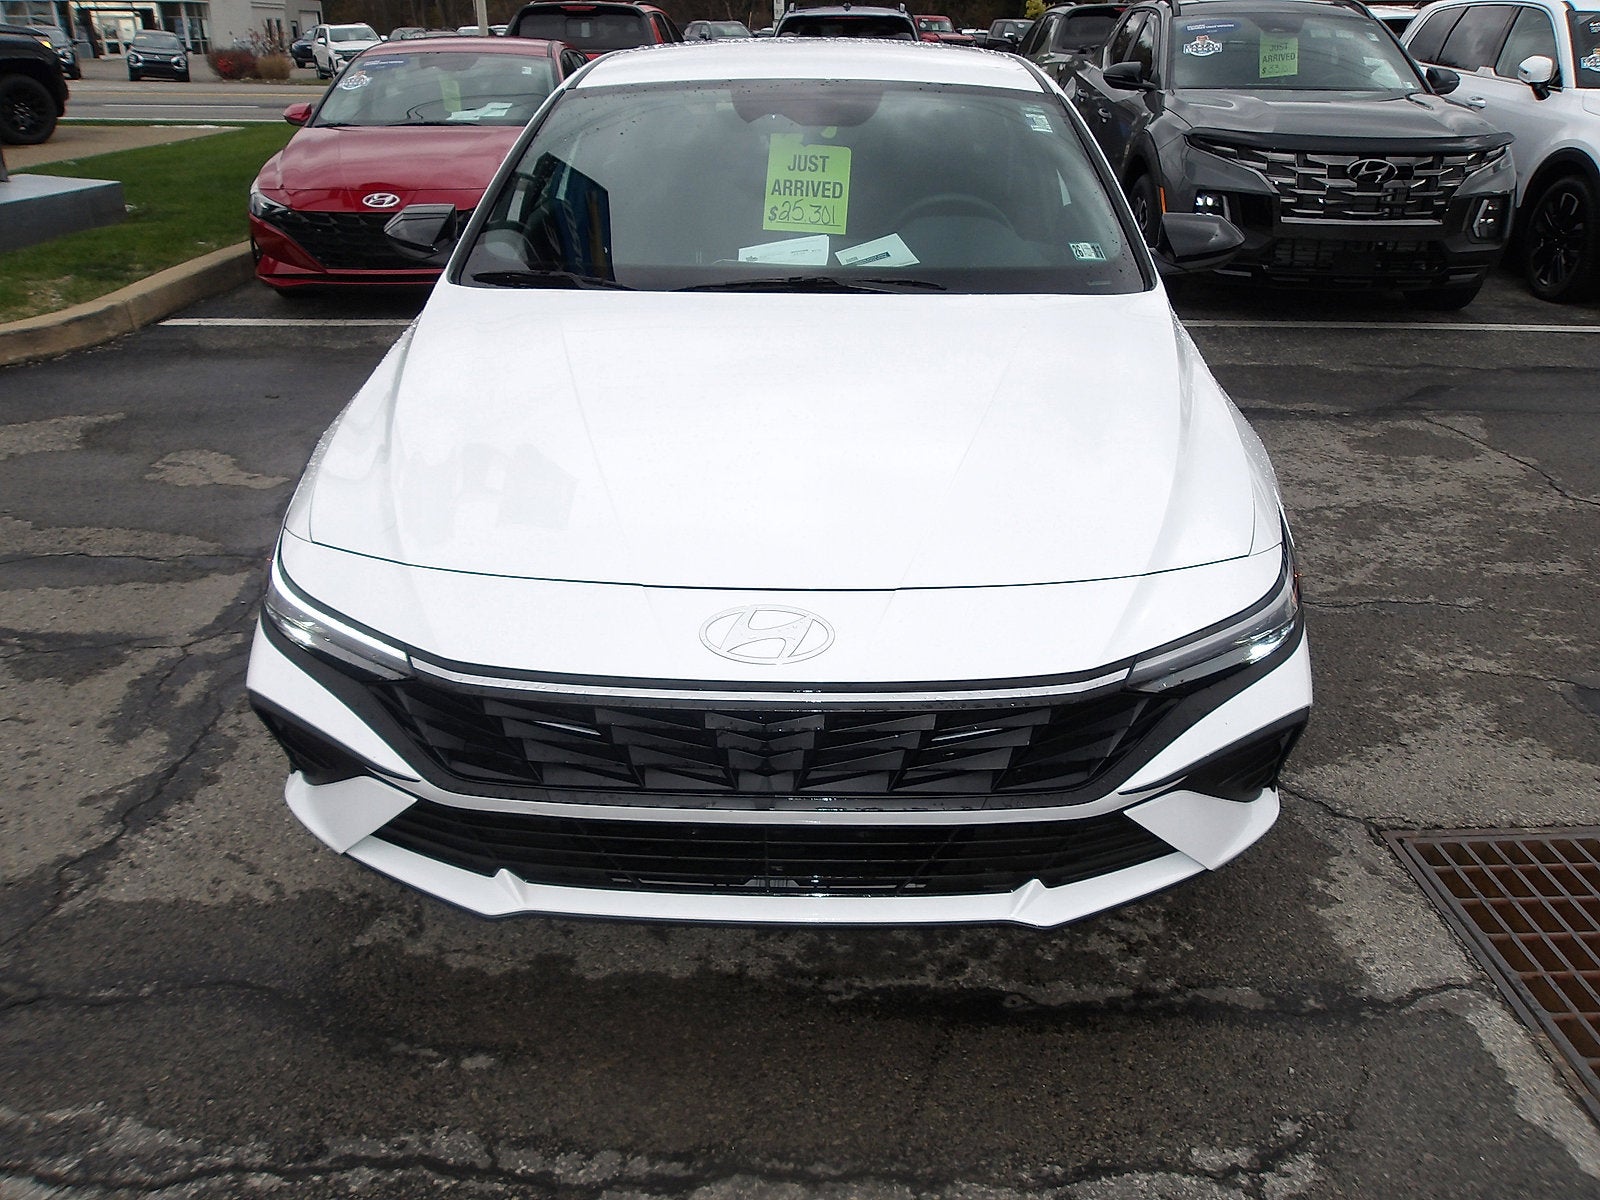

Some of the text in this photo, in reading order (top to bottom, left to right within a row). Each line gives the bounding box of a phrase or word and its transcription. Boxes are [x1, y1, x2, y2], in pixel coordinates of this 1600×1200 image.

[1270, 43, 1288, 51] JUST
[1262, 53, 1296, 63] ARRIVED
[787, 154, 830, 173] JUST
[771, 179, 844, 199] ARRIVED
